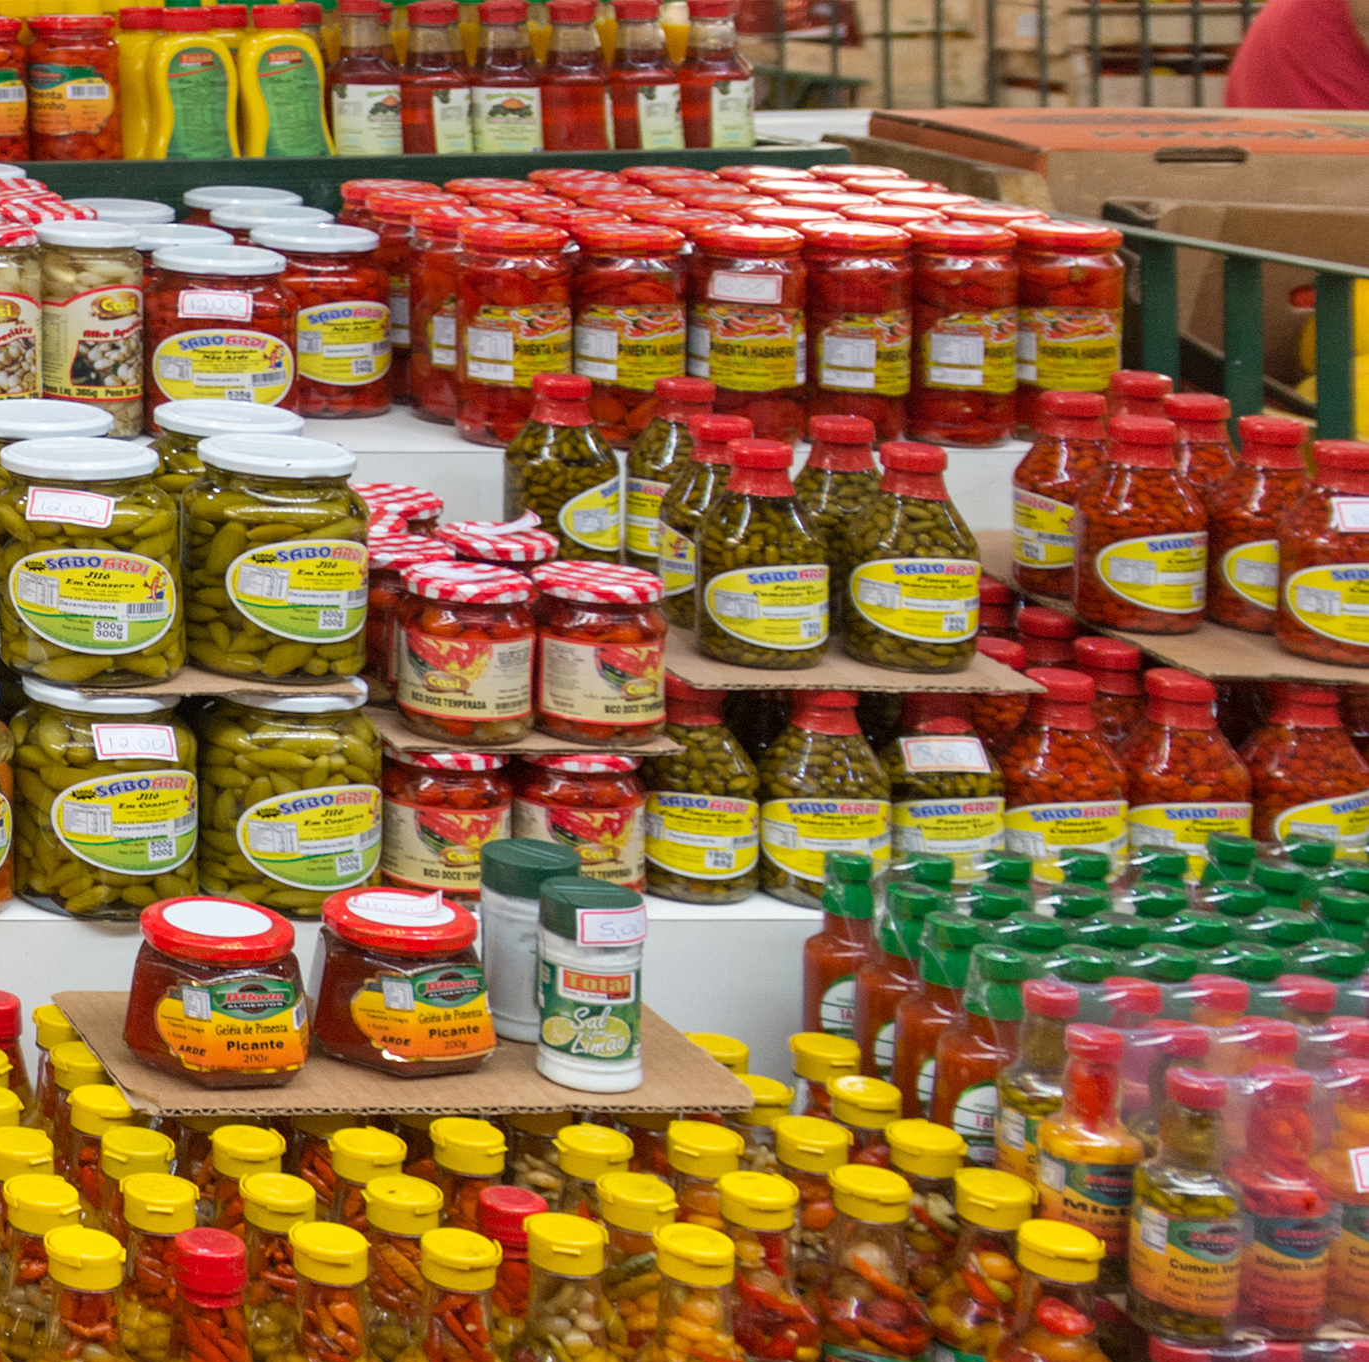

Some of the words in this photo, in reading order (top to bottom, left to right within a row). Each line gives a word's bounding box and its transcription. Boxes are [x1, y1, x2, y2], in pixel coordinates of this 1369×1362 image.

[96, 621, 123, 632] 500g
[96, 630, 123, 640] 300g
[565, 971, 630, 993] Total
[428, 1023, 481, 1037] Picante
[227, 1039, 285, 1051] Picante
[380, 1035, 411, 1047] ARDE
[178, 1044, 207, 1057] ARDE
